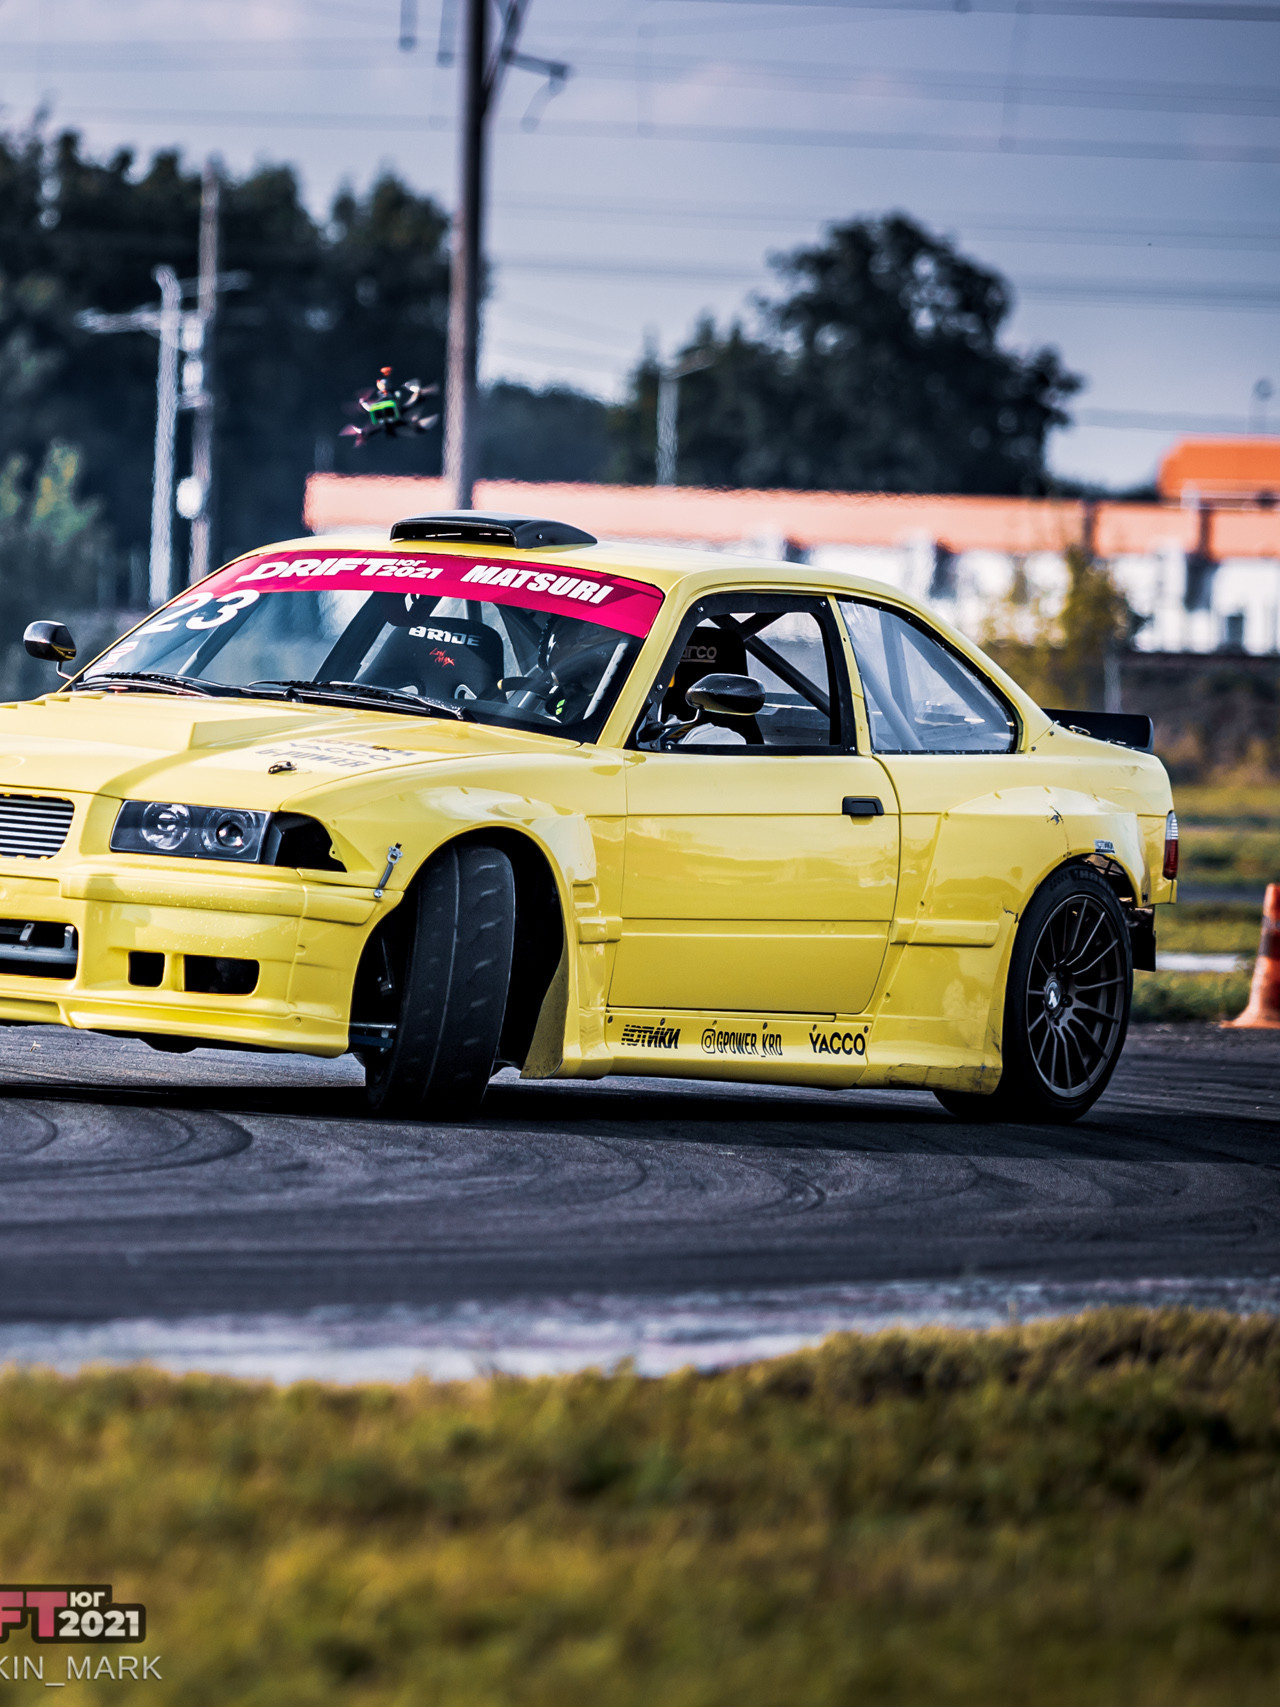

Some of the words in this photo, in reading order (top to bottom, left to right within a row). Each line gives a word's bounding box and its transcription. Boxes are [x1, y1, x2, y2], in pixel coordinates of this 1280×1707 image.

[235, 557, 399, 583] DRIFT
[377, 565, 444, 579] 2021
[460, 564, 614, 604] MATSURI
[135, 589, 260, 636] 23
[408, 626, 482, 646] BRIDE
[289, 742, 392, 761] YACCO
[809, 1032, 866, 1056] YACCO
